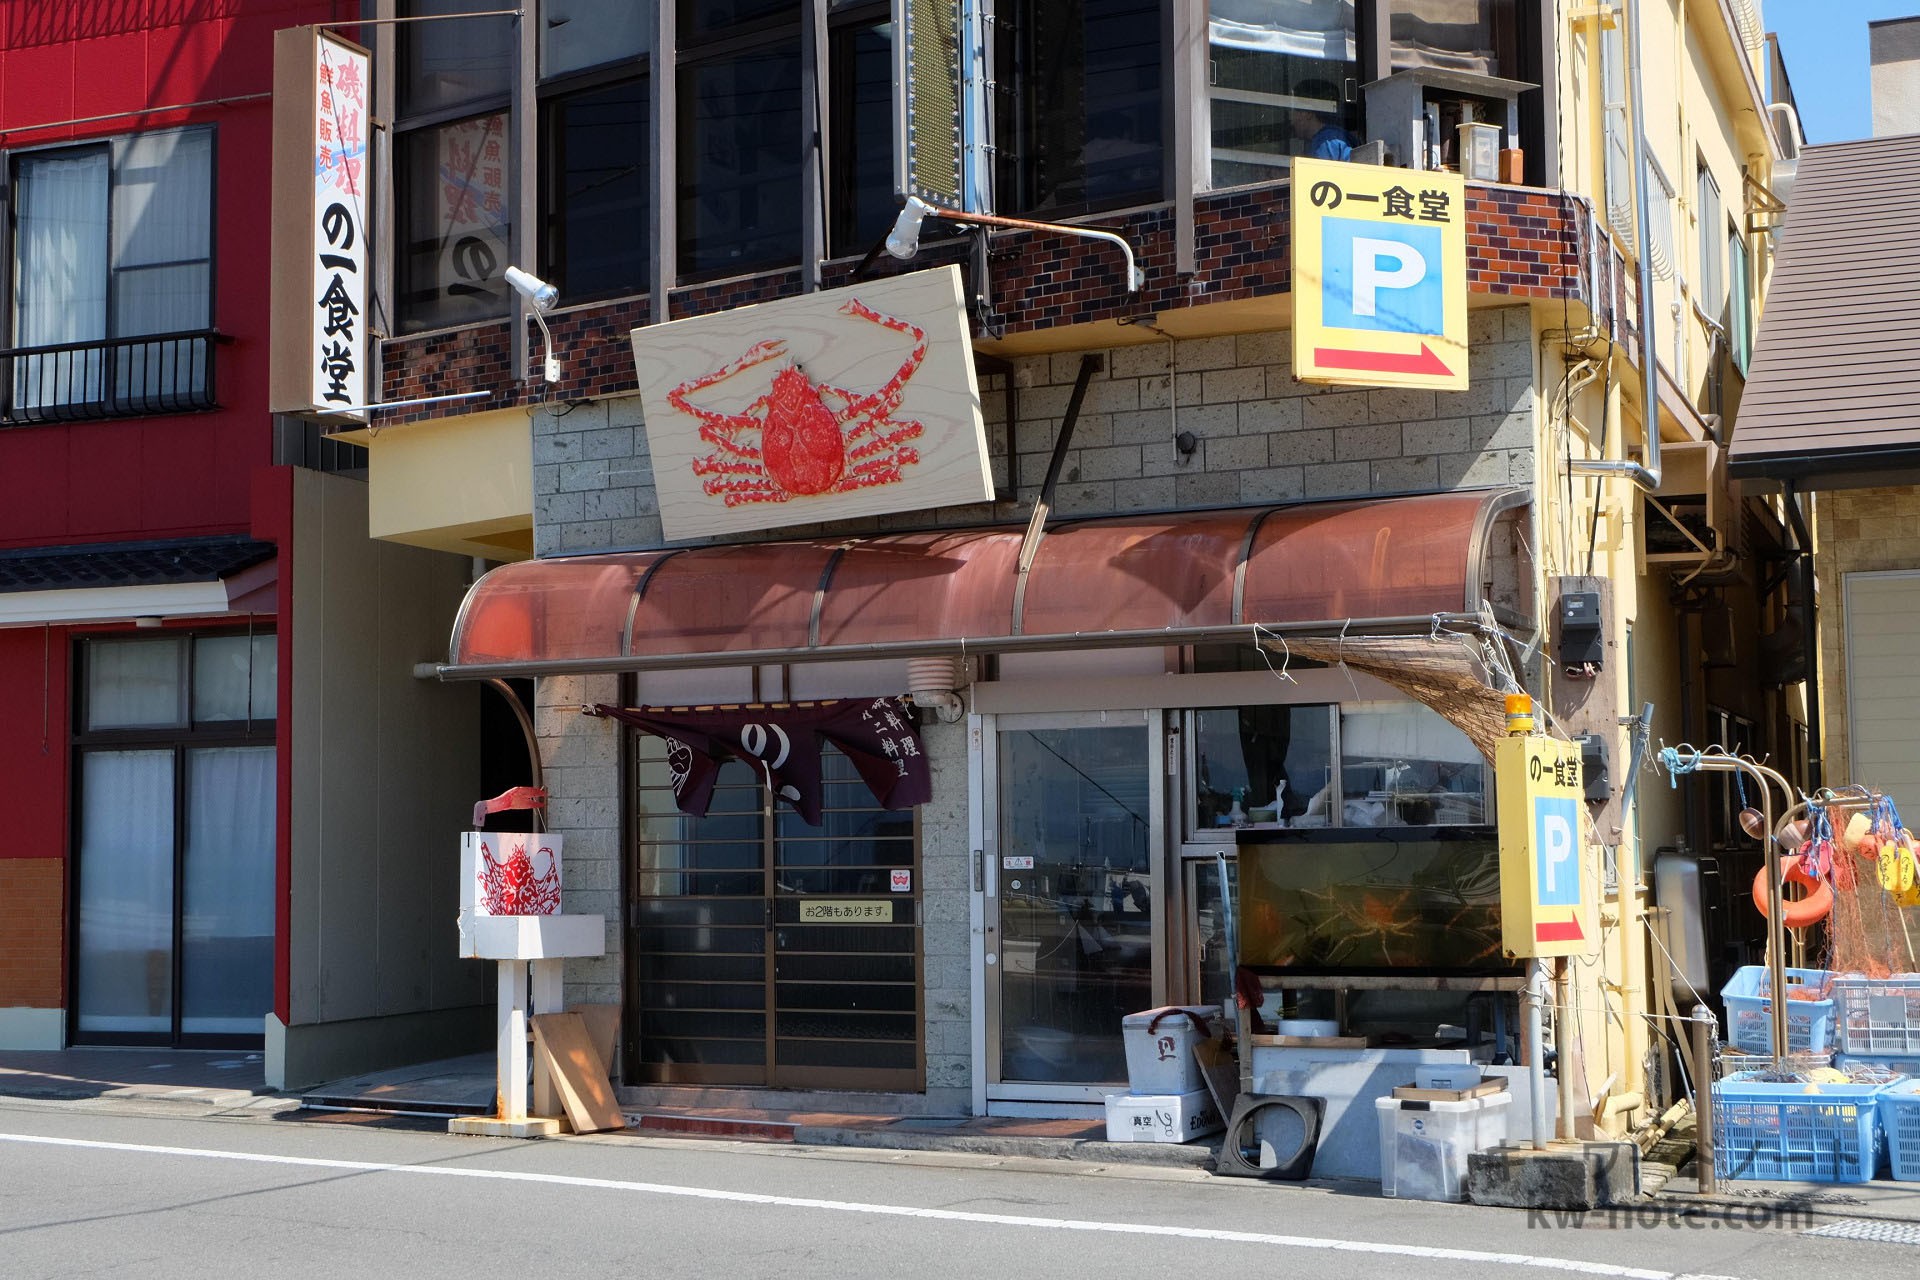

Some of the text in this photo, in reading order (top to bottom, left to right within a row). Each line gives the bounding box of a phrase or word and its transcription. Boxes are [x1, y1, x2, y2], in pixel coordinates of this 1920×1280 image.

[335, 55, 363, 197] 磯料理
[1310, 180, 1451, 223] の一食堂
[318, 203, 359, 405] の一食堂
[1352, 236, 1427, 317] P
[1530, 755, 1578, 787] の一食堂
[1543, 814, 1571, 893] P
[805, 905, 888, 918] お2階もあります。
